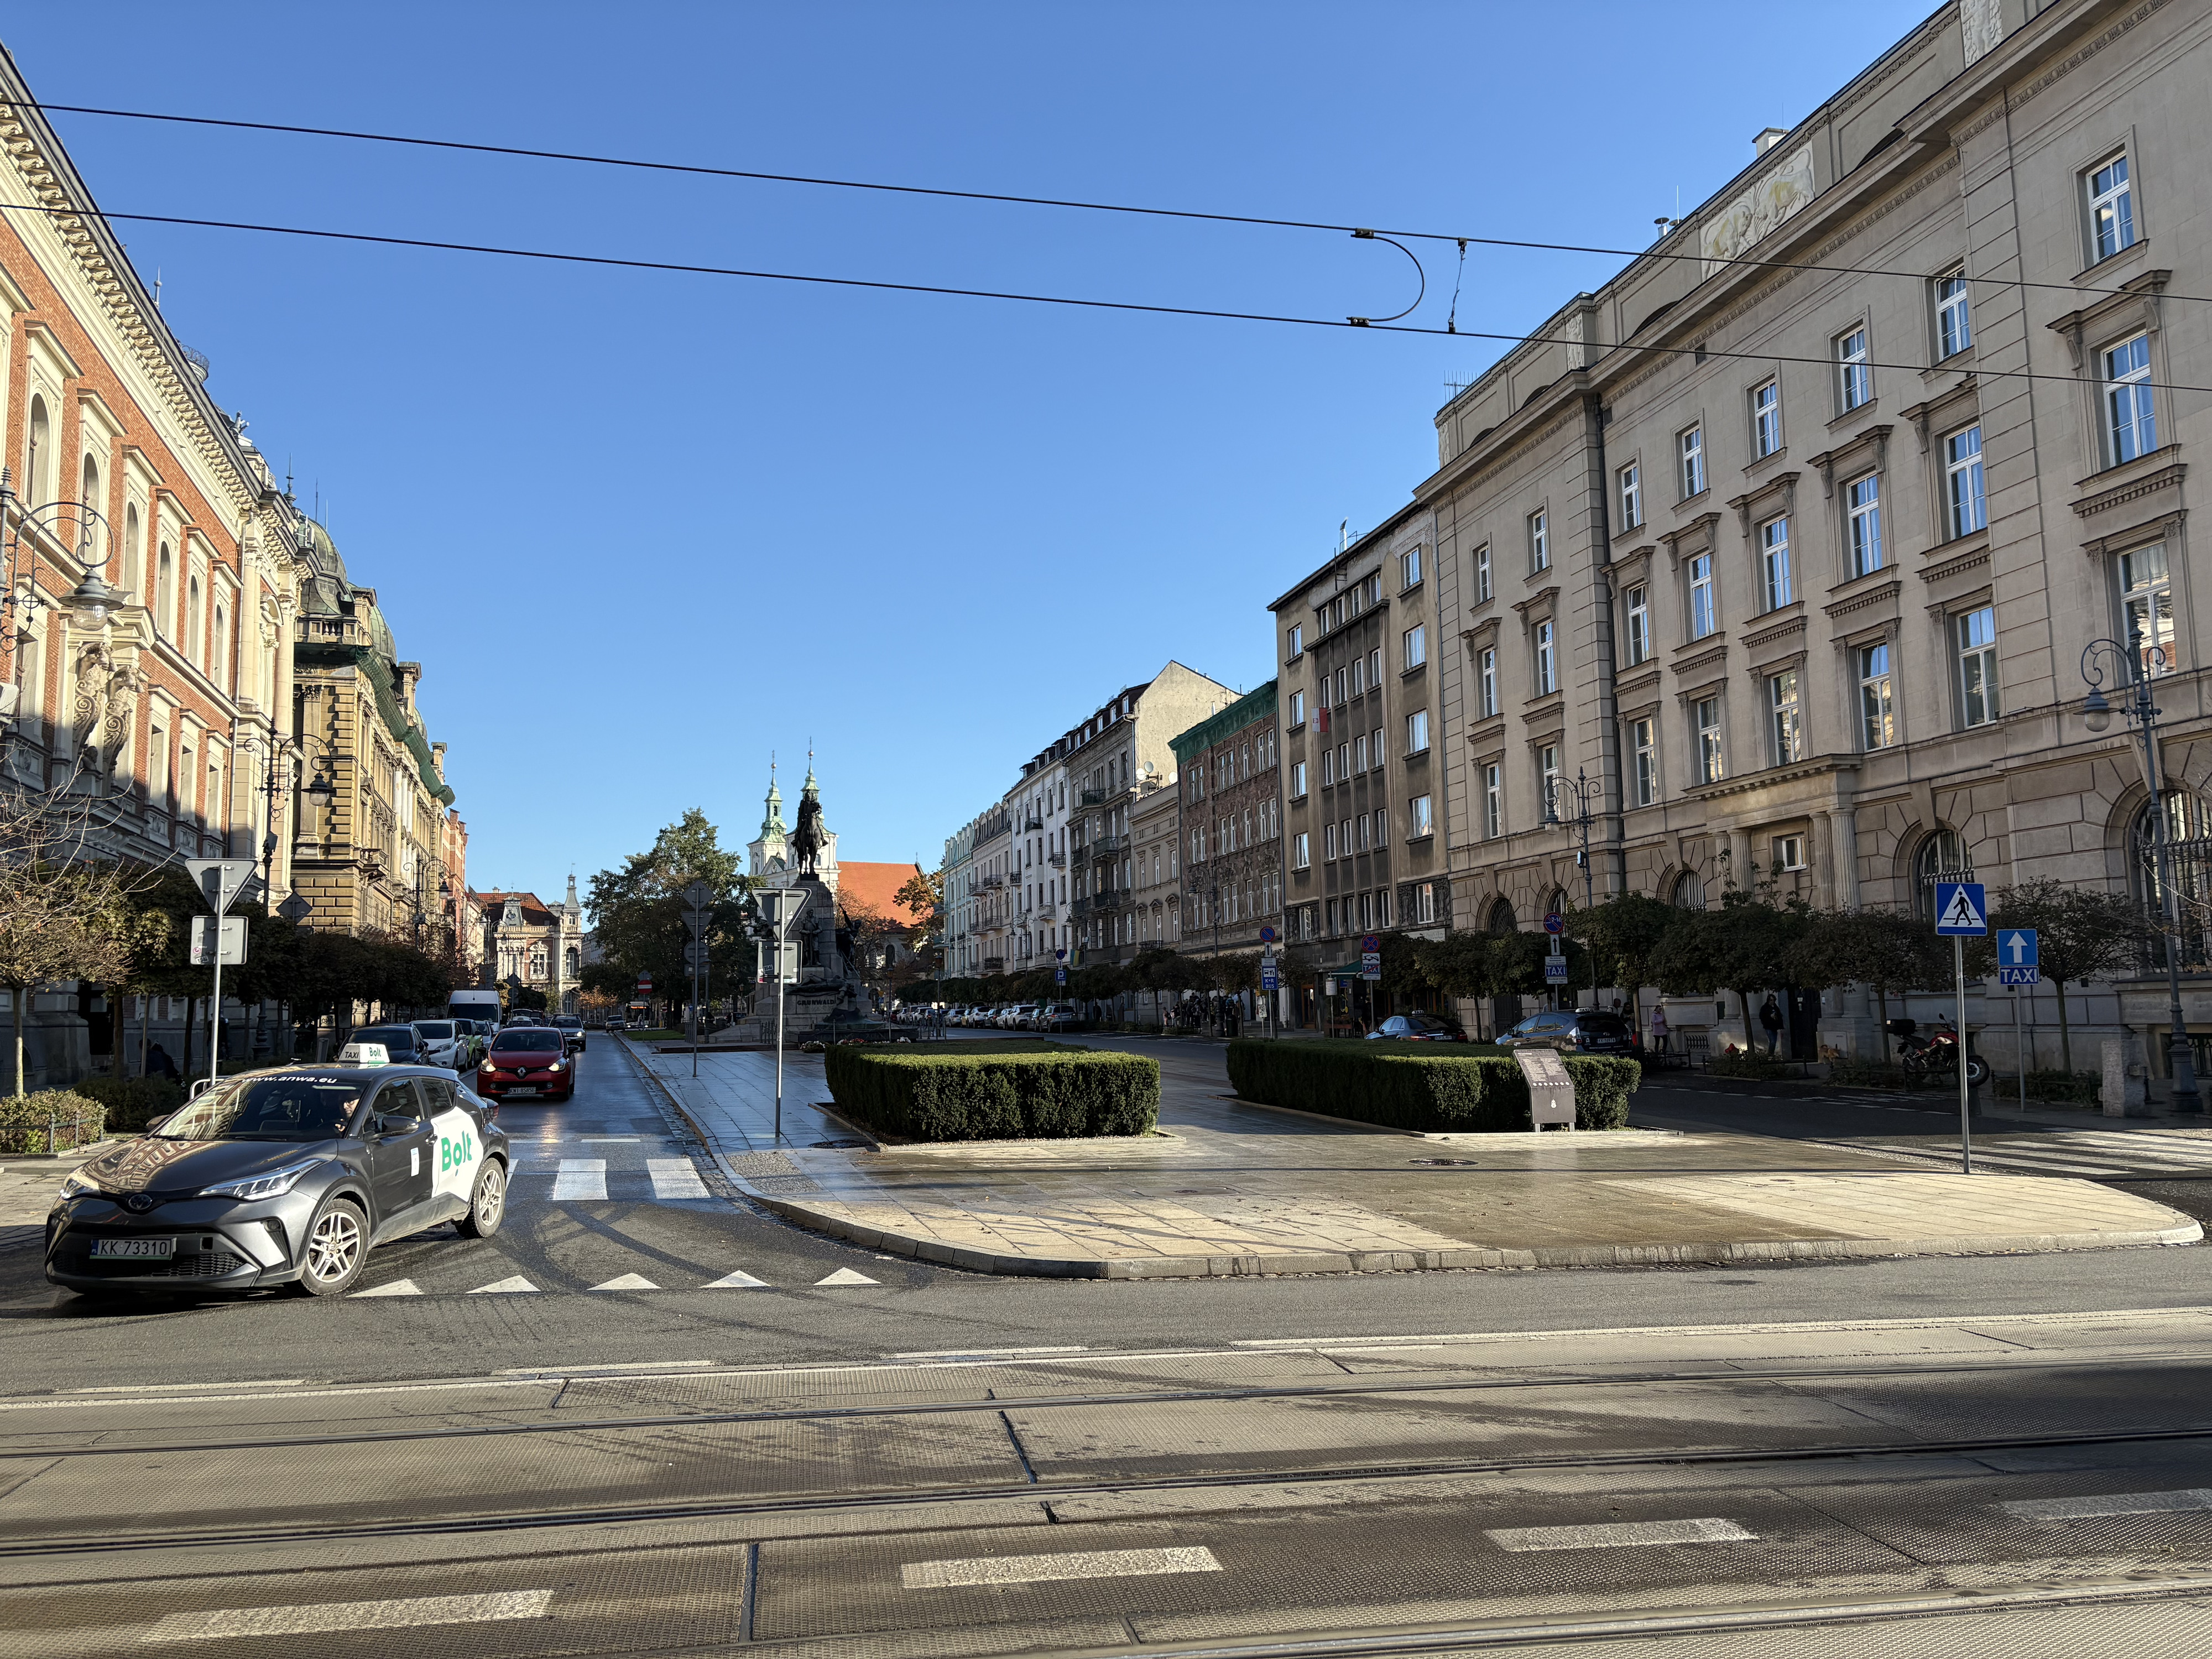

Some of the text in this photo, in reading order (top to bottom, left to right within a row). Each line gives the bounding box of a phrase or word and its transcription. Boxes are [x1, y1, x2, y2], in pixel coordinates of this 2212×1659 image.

[1057, 971, 1064, 979] P
[1546, 967, 1566, 975] TAXI
[2001, 969, 2038, 982] TAXI
[369, 1047, 382, 1059] Bolt
[441, 1130, 472, 1175] Bolt
[101, 1240, 118, 1254] KK
[123, 1241, 167, 1255] 73310
